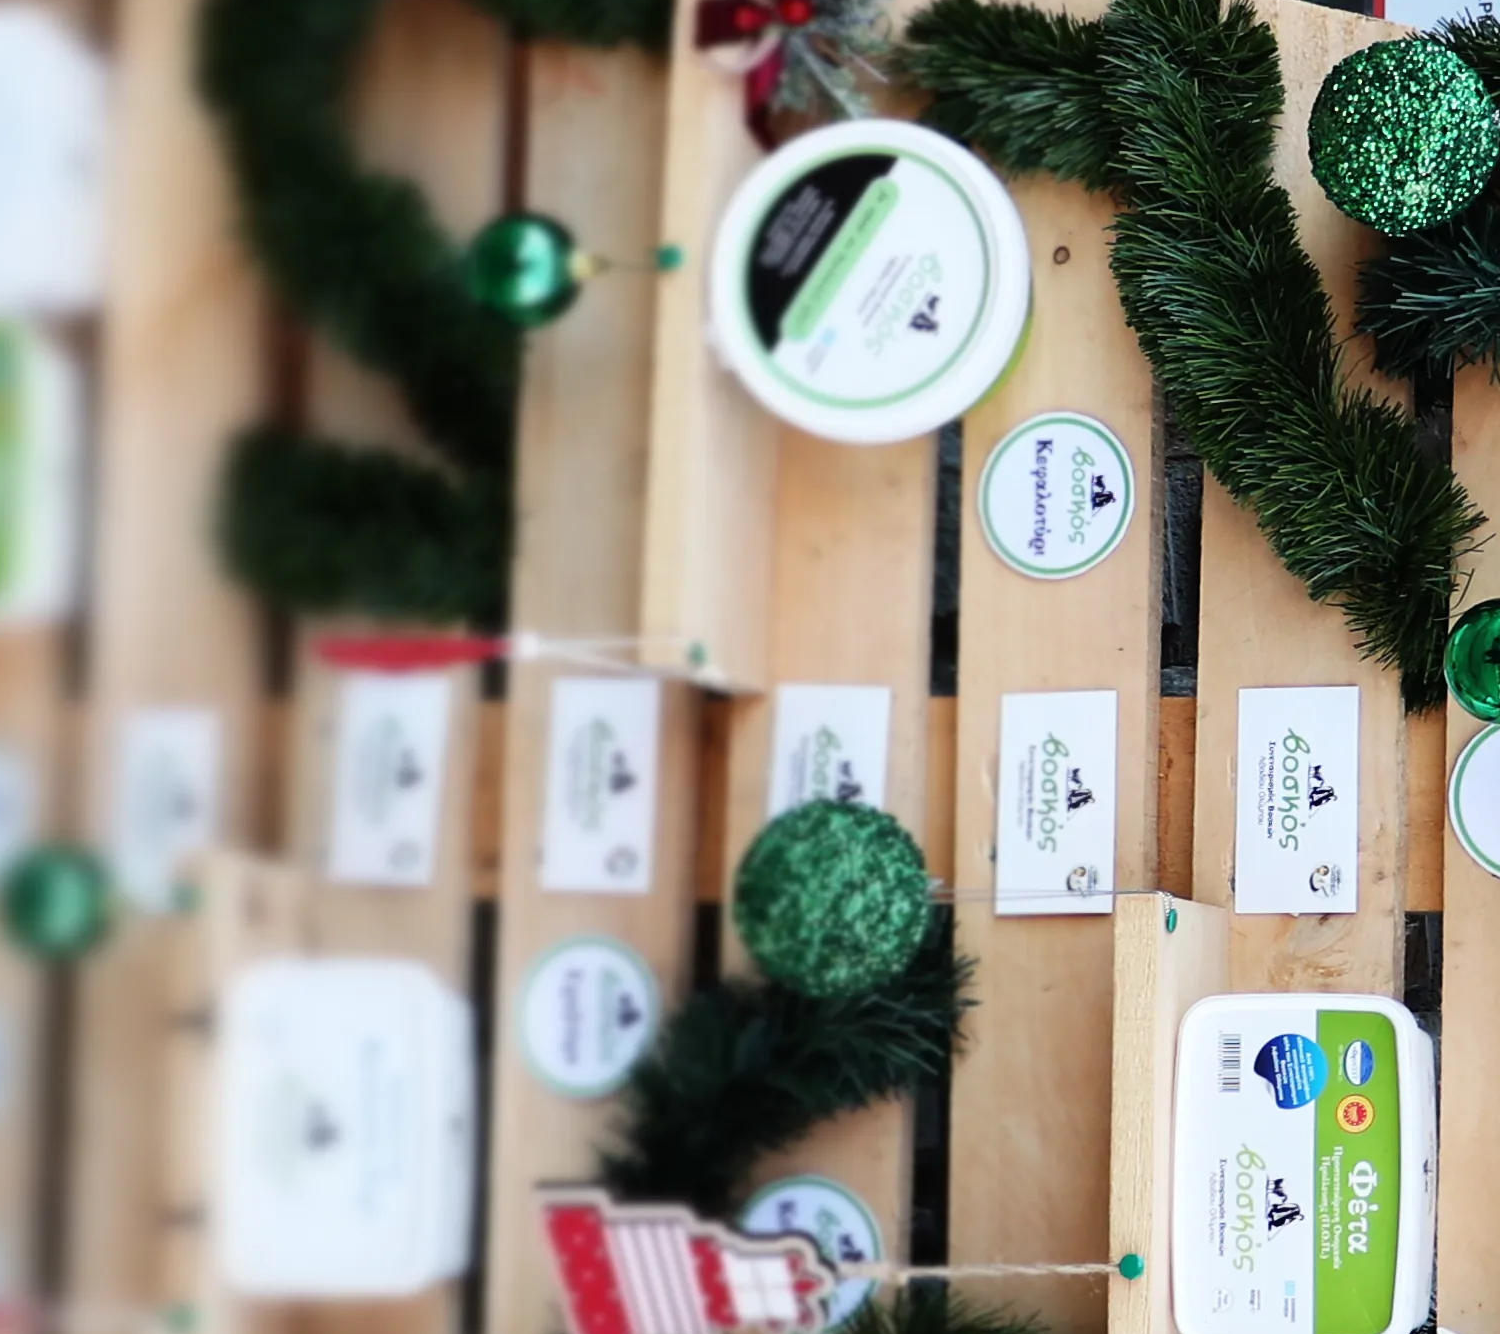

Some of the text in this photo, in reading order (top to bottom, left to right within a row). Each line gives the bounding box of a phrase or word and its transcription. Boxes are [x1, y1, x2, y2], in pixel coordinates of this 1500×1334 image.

[1028, 439, 1053, 556] Κεφαλοτύρι
[1067, 446, 1095, 545] βοσκός
[1037, 732, 1069, 853] βοσκός
[1267, 741, 1276, 839] Συνεταιρισμός Βοσκών
[1278, 728, 1310, 852] βοσκός
[1230, 1143, 1266, 1273] βοσκός
[1320, 1214, 1331, 1260] (Π.Ο.Π.)
[1348, 1161, 1379, 1255] Φέτα
